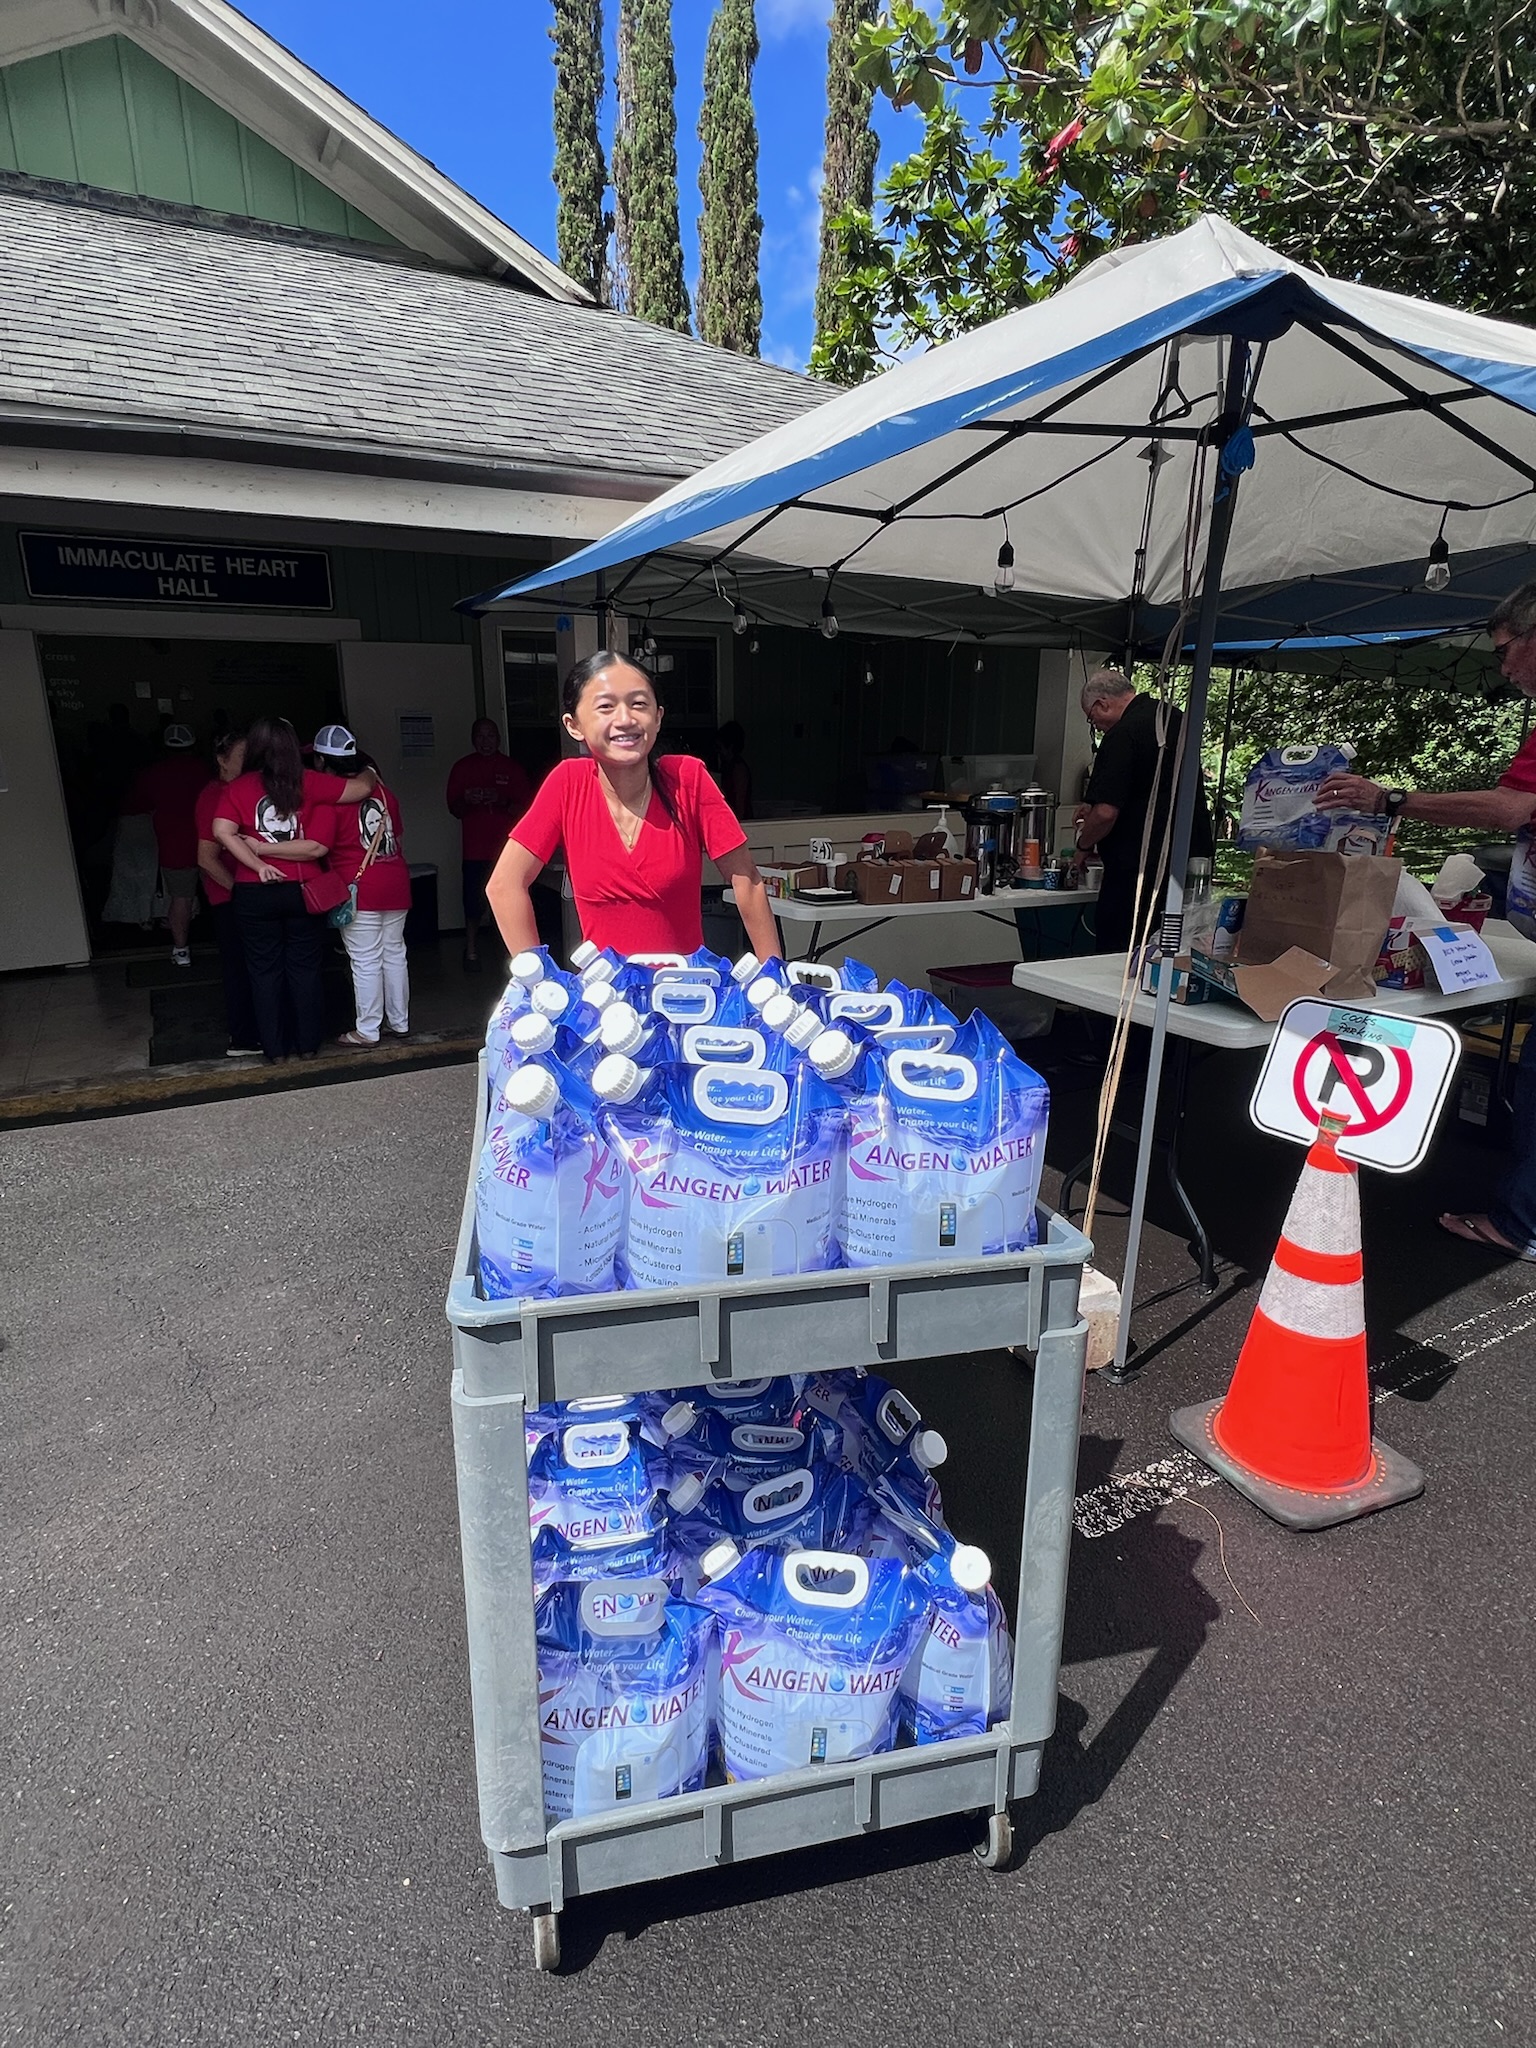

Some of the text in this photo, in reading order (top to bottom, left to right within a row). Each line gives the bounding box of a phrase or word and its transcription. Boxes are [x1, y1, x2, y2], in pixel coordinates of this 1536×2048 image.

[58, 546, 299, 578] IMMACULATE HEART
[158, 577, 218, 598] HALL
[1300, 783, 1321, 793] WAT
[1341, 1012, 1377, 1026] COOKS
[930, 1077, 948, 1086] Life
[725, 1095, 745, 1103] your
[898, 1118, 979, 1133] Change your Life
[694, 1142, 781, 1158] Change your Life
[969, 1137, 1033, 1174] WATER
[766, 1159, 832, 1195] WATER
[856, 1197, 898, 1210] Hydrogen
[583, 1219, 606, 1235] Active
[860, 1214, 897, 1226] Minerals
[643, 1223, 684, 1238] Hydrogen
[647, 1240, 683, 1255] Minerals
[859, 1246, 893, 1258] Alkaline
[644, 1274, 679, 1287] Alkaline
[567, 1487, 596, 1497] Change
[597, 1485, 614, 1493] your
[556, 1516, 607, 1539] NGEN
[764, 1612, 785, 1624] your
[786, 1627, 863, 1645] Change your Life
[584, 1658, 665, 1674] Change your Life
[719, 1630, 902, 1703] KANGEN WATE
[736, 1708, 774, 1729] Hydrogen
[739, 1723, 773, 1742] Minerals
[542, 1759, 575, 1772] ydrogen
[737, 1752, 768, 1769] Alkaline
[544, 1802, 572, 1814] lkaline
